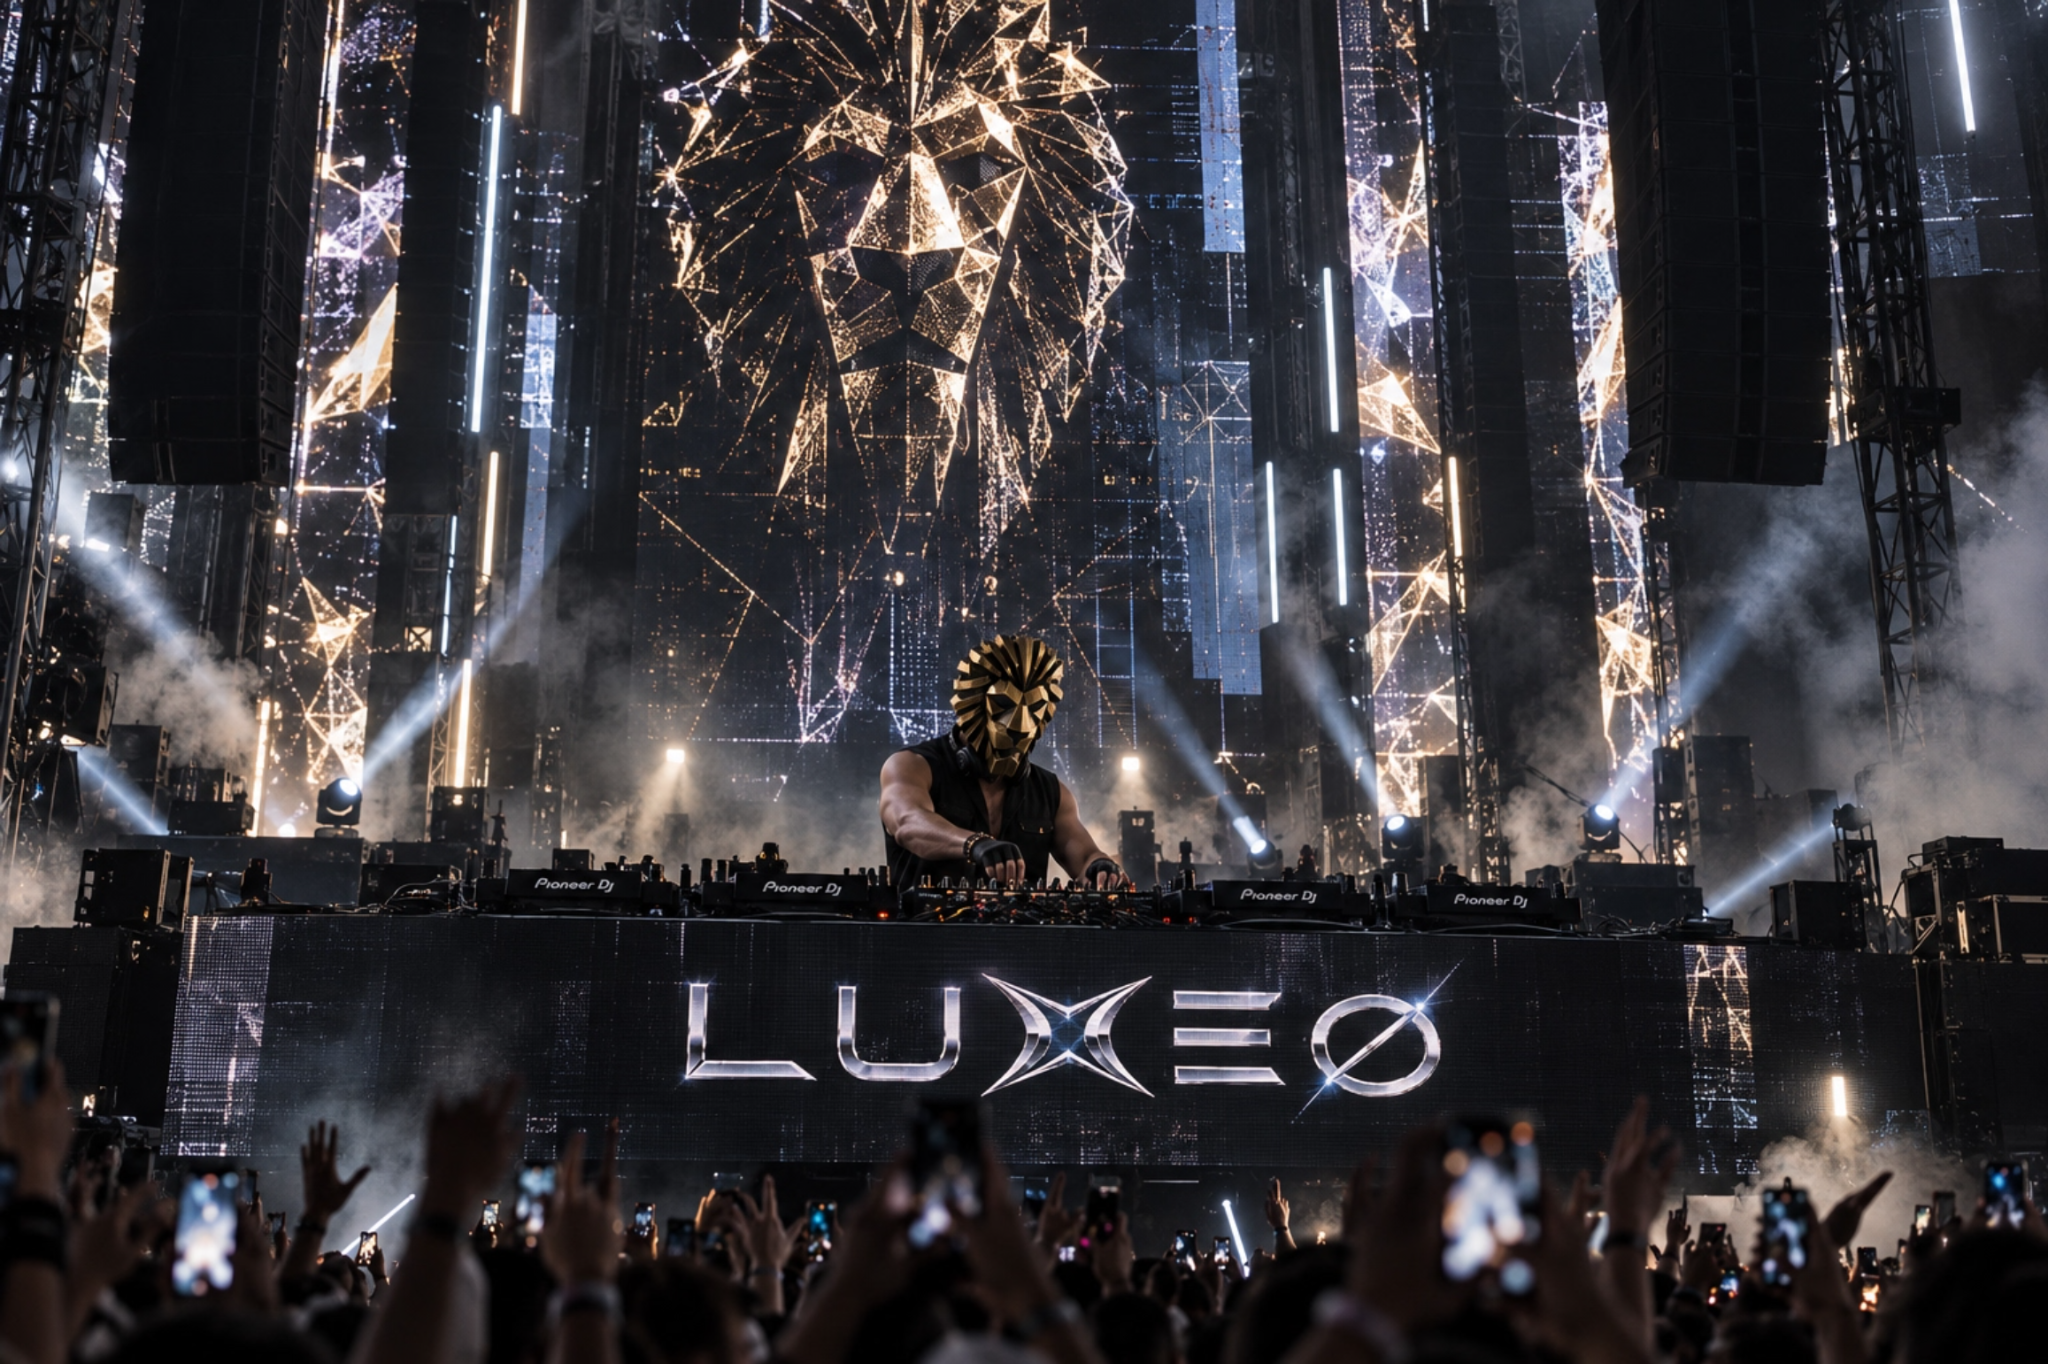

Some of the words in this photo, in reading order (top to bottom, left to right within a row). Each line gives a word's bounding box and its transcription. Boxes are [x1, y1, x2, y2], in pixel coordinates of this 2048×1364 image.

[535, 877, 595, 889] Pioneer
[762, 881, 823, 893] Pioneer
[1240, 888, 1299, 900] Pioneer
[1454, 893, 1510, 906] Pioneer
